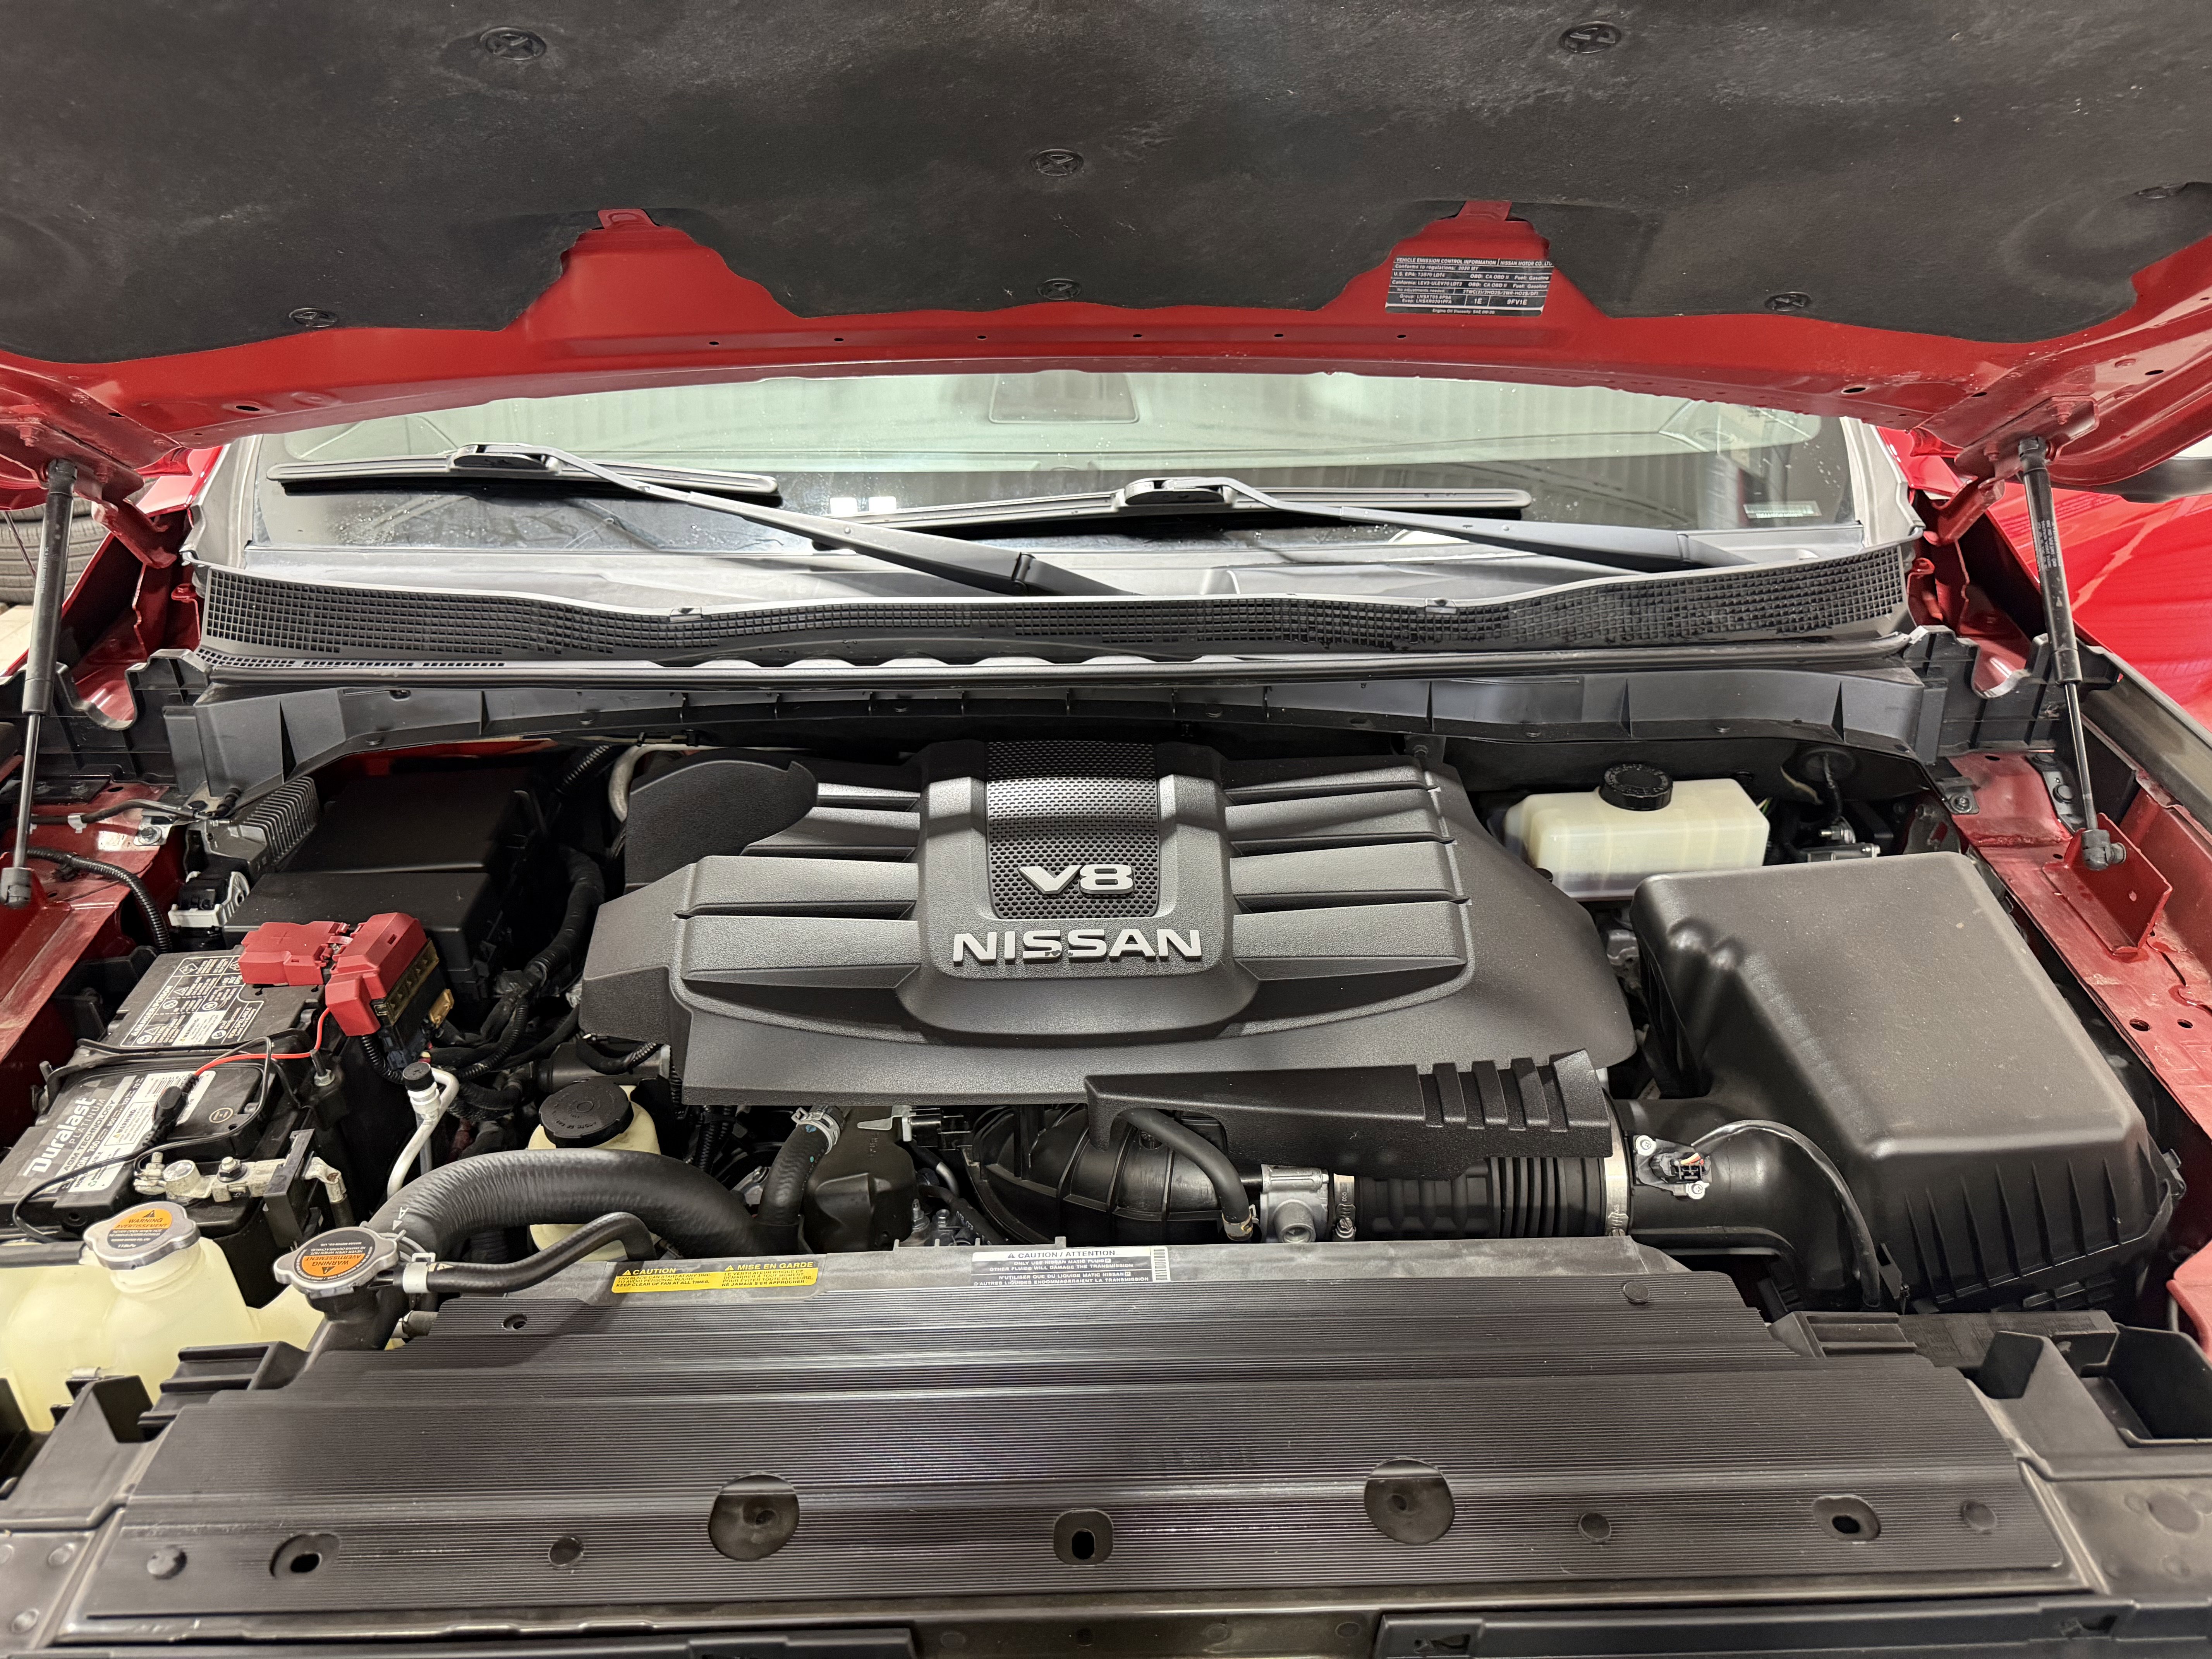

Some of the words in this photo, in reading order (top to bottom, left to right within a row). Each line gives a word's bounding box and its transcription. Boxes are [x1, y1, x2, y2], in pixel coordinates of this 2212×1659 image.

[1018, 864, 1133, 894] V8
[953, 929, 1201, 962] NISSAN
[22, 1097, 97, 1176] Duralast
[64, 1152, 80, 1171] AGM
[79, 1100, 116, 1150] TECHNOLOGY
[69, 1099, 106, 1144] PLATINUM
[87, 1140, 100, 1153] 760
[398, 1207, 409, 1219] A
